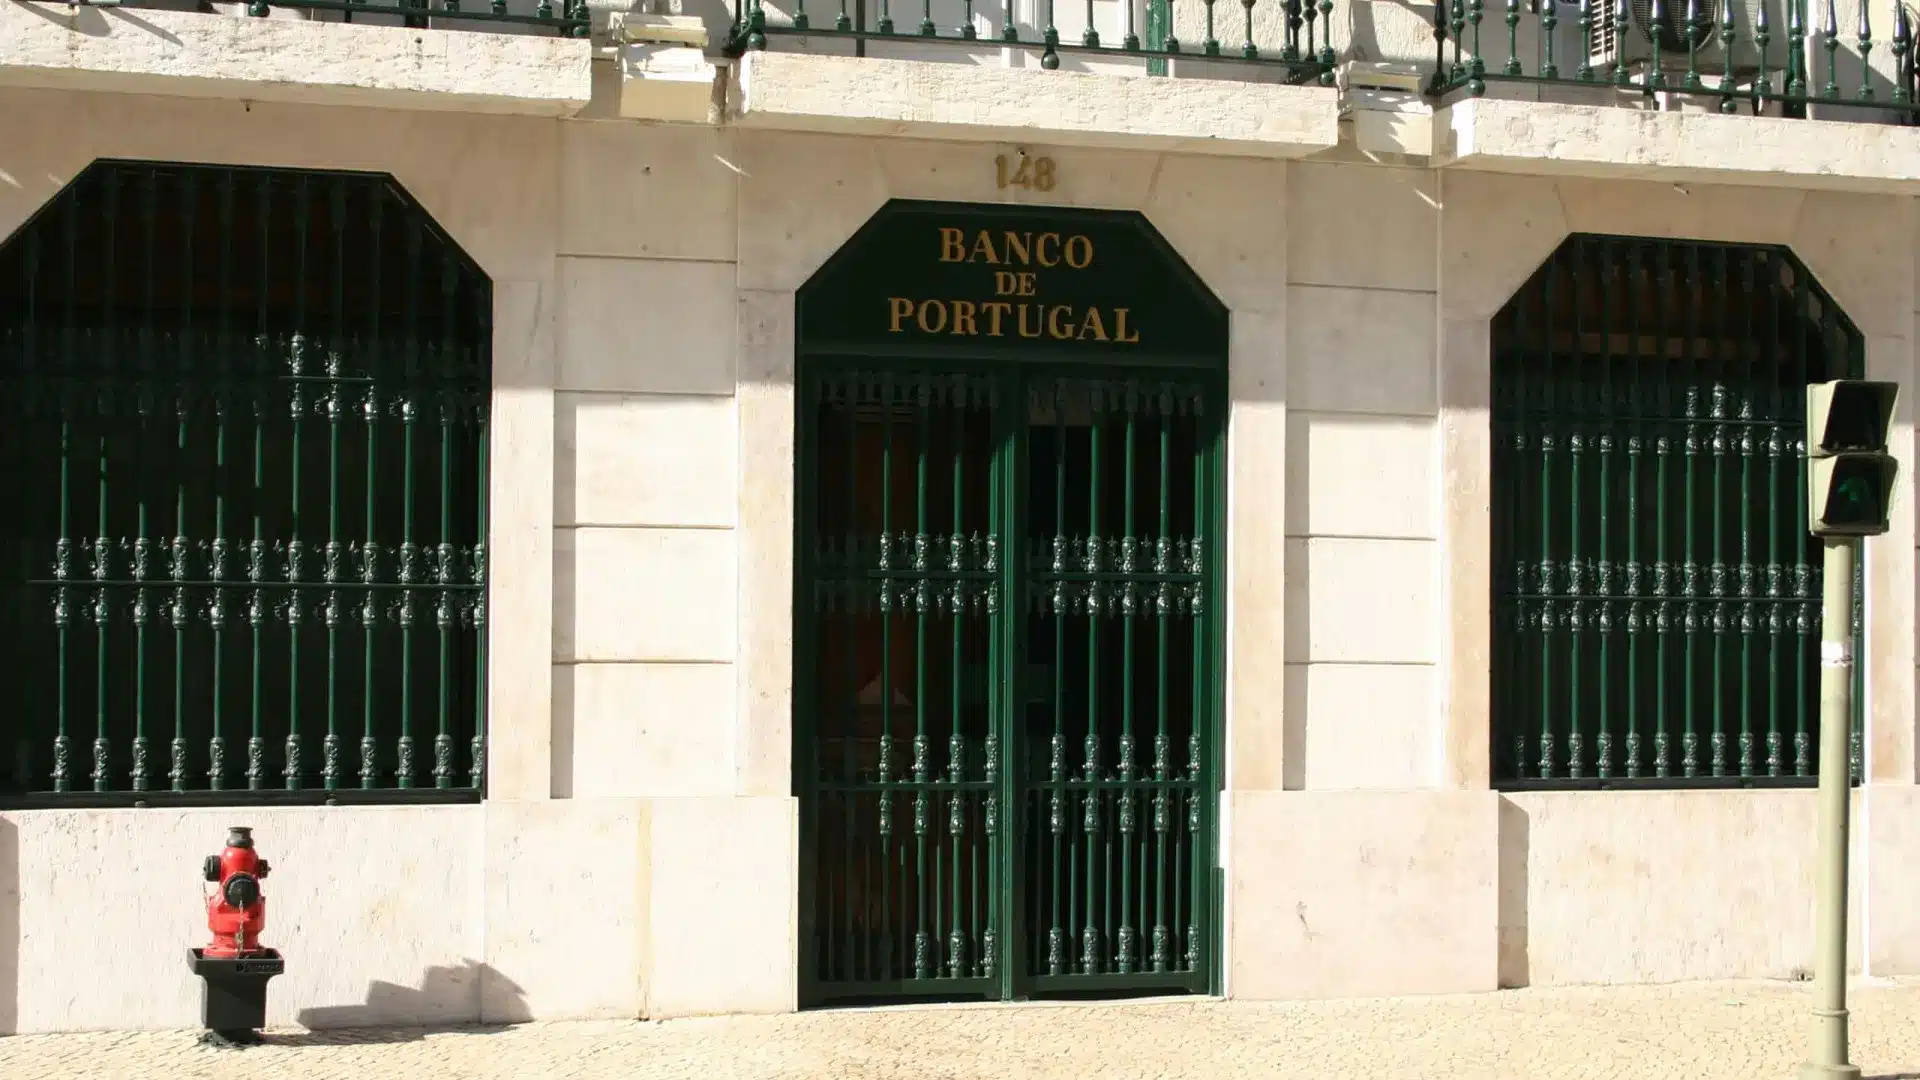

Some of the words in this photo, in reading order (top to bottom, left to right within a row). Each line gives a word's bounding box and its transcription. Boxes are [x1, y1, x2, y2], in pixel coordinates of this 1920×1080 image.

[995, 154, 1055, 191] 148
[938, 228, 1093, 268] BANCO
[995, 272, 1036, 296] DE
[888, 297, 1139, 342] PORTUGAL
